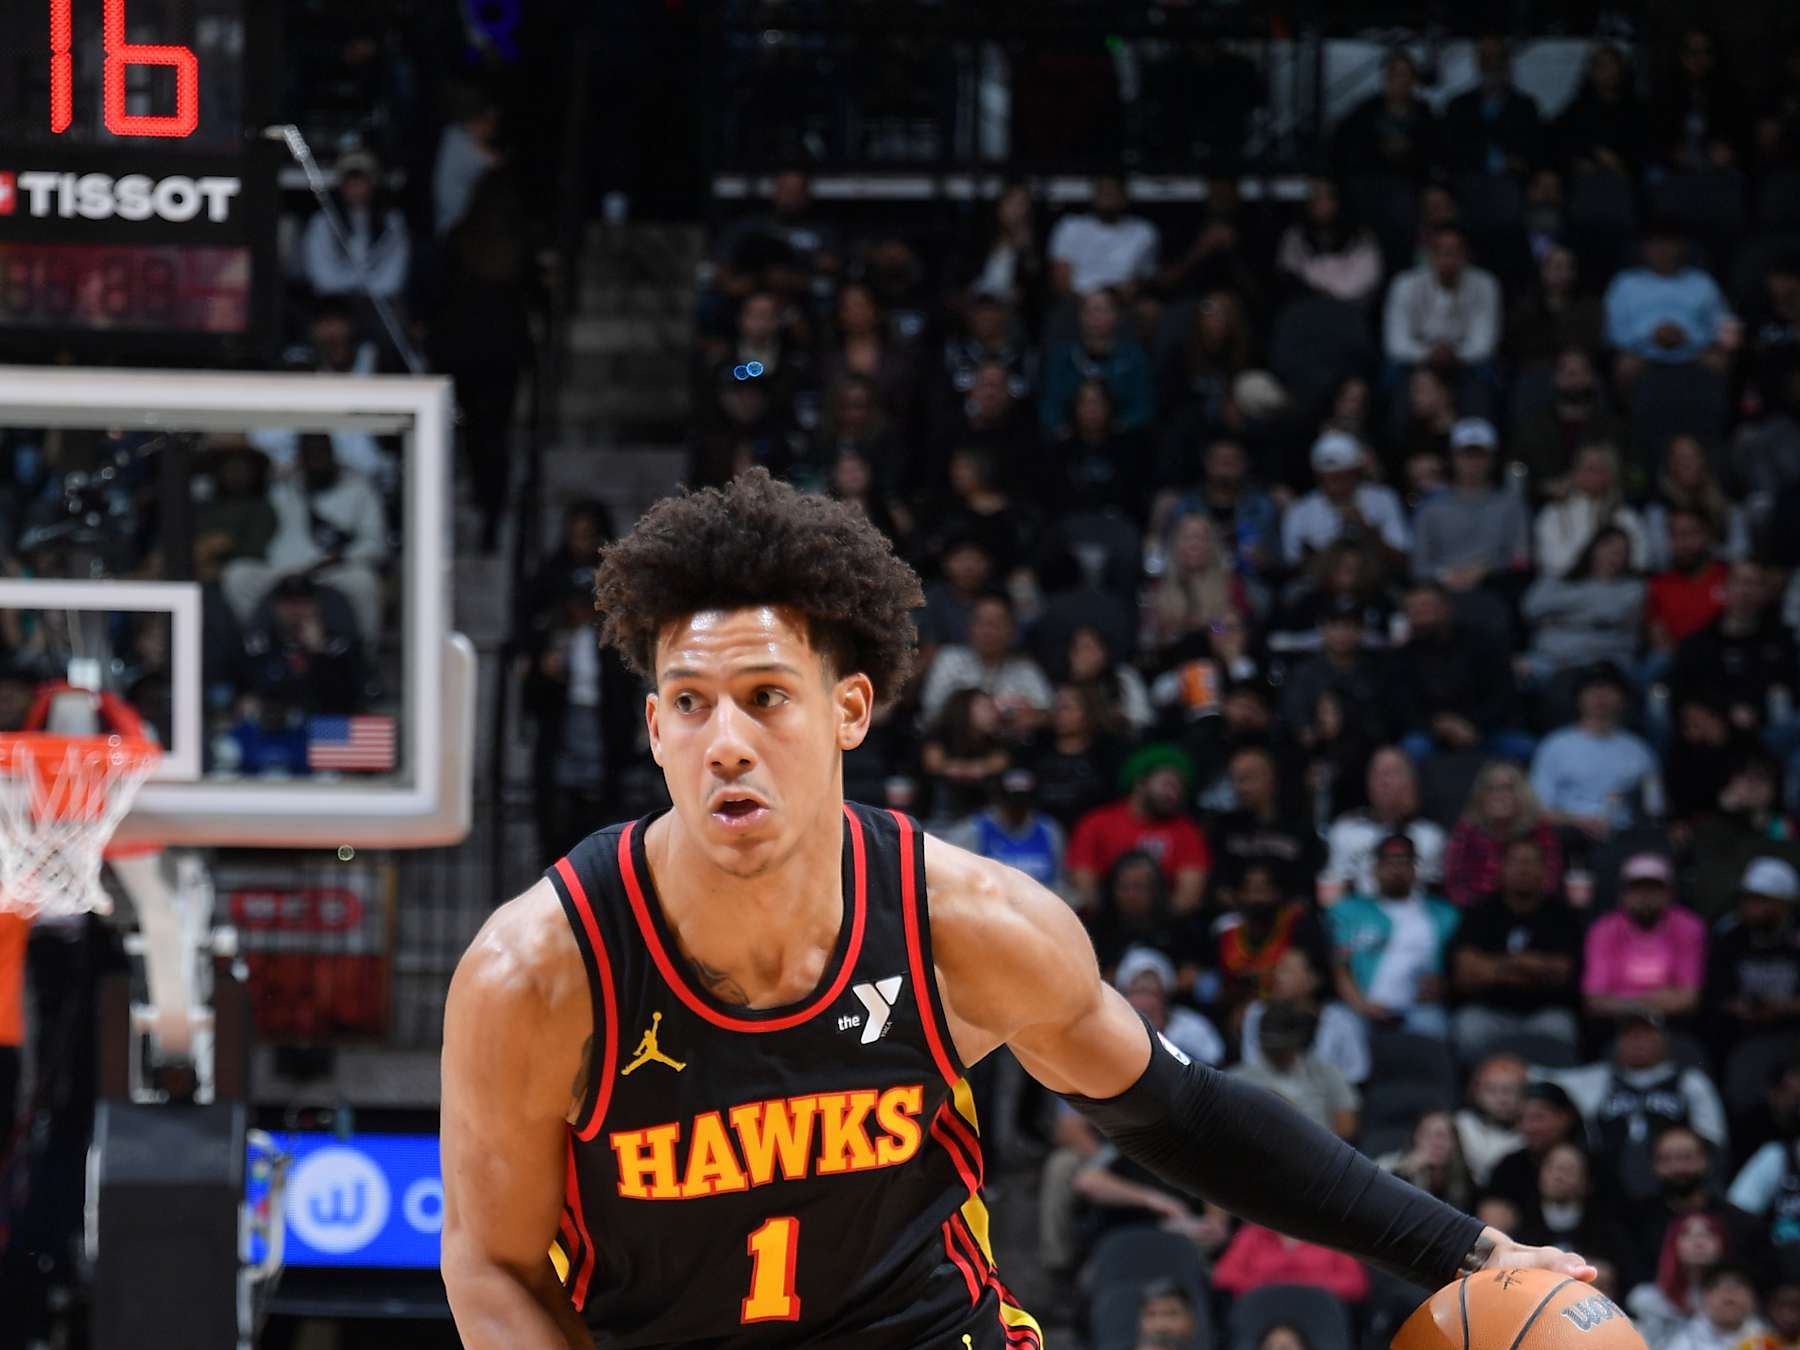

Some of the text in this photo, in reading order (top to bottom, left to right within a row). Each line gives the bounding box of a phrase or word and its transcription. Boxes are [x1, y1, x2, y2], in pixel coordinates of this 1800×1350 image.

[50, 0, 199, 138] 16
[17, 171, 242, 223] TISSOT
[838, 1015, 861, 1031] the
[609, 1085, 924, 1200] HAWKS
[741, 1216, 801, 1324] 1
